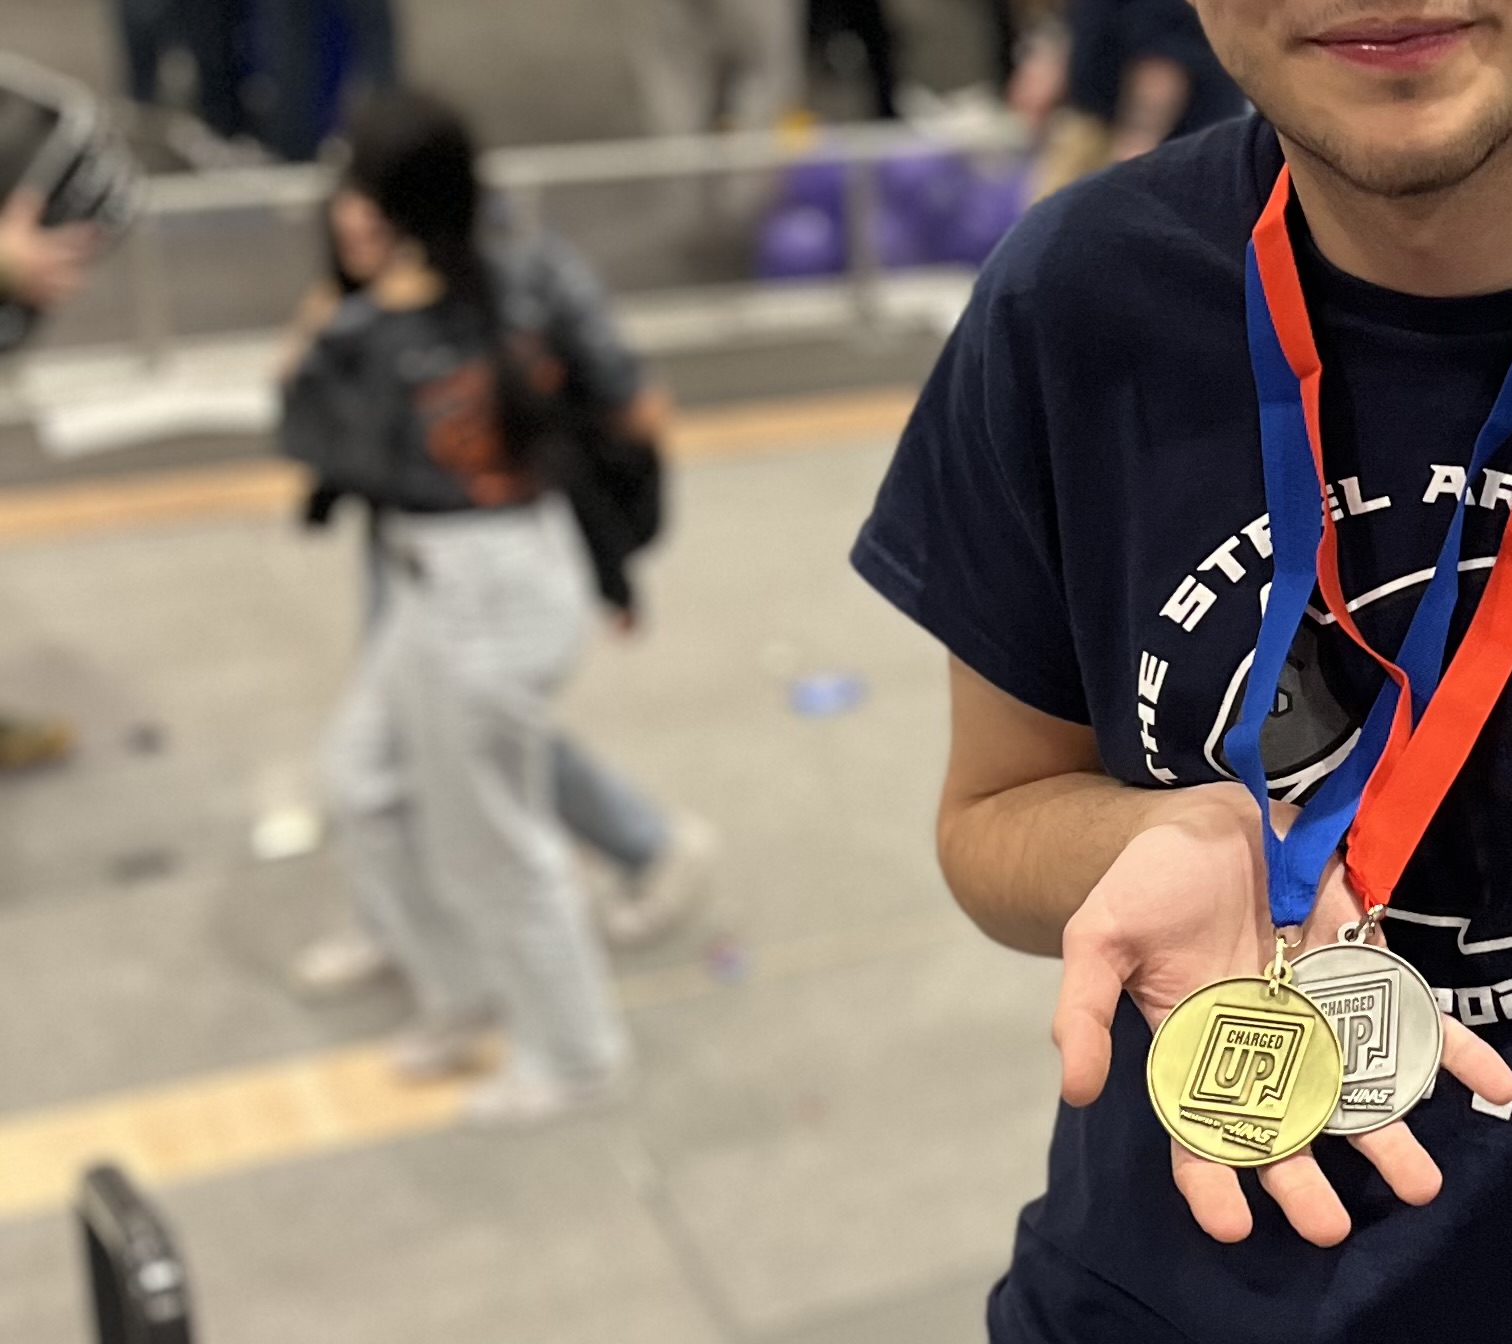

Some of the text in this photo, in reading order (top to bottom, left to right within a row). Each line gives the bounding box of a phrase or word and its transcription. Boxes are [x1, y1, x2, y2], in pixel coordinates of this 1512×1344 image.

[1137, 650, 1179, 786] THE
[1158, 475, 1392, 633] STEL
[1320, 994, 1375, 1017] CHARGED
[1226, 1028, 1284, 1050] CHARGED
[1214, 1045, 1276, 1106] UP
[1341, 1088, 1394, 1104] HAAS
[1224, 1121, 1278, 1144] HAAS
